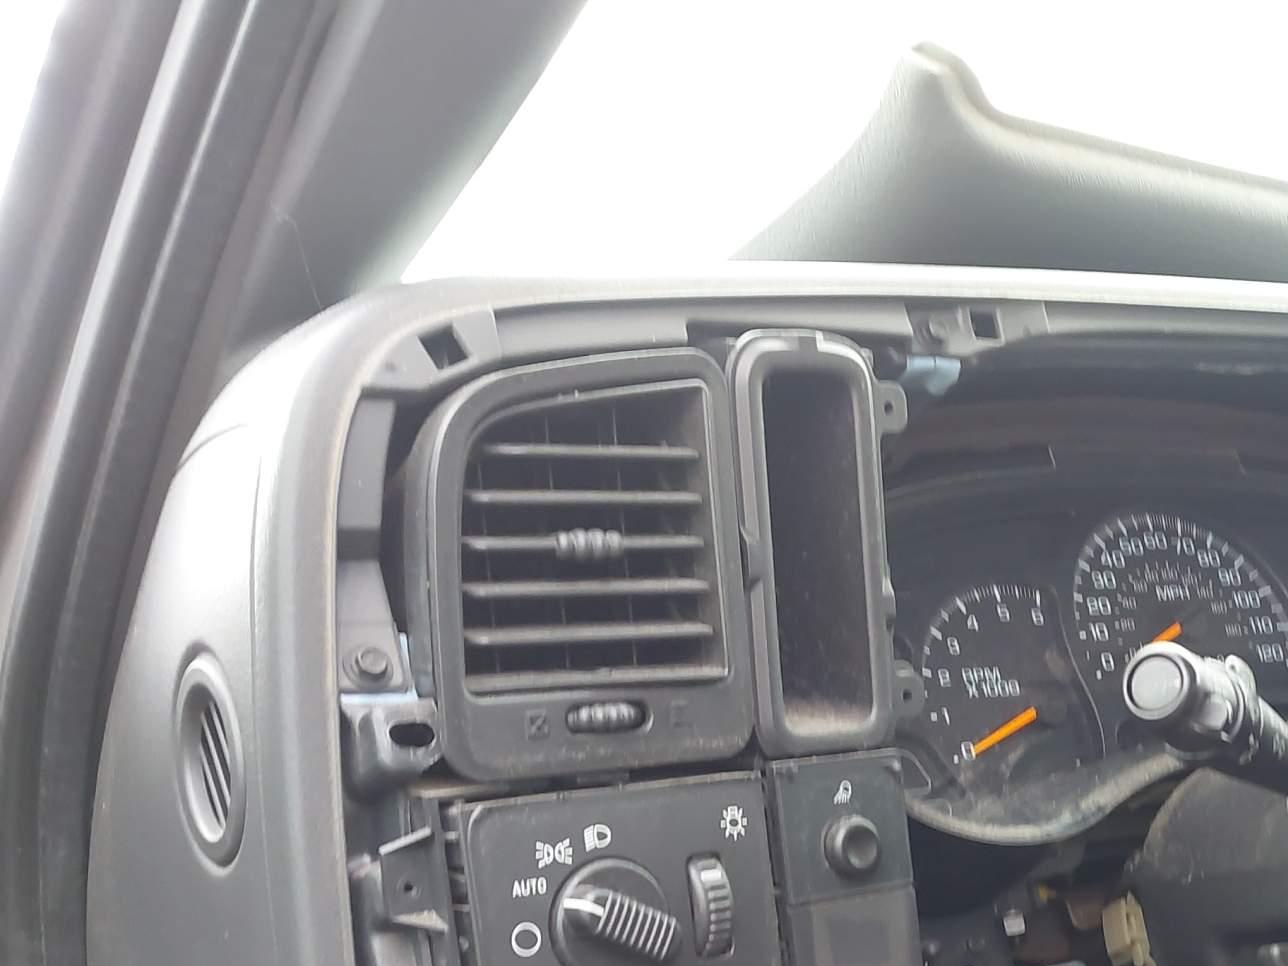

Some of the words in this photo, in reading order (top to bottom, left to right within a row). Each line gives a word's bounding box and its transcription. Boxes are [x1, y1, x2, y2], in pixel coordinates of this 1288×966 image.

[1170, 536, 1195, 555] 70
[1101, 549, 1125, 568] 40
[1155, 584, 1190, 601] MPH
[1231, 590, 1261, 609] 100
[966, 613, 979, 632] 4
[996, 603, 1011, 622] 5
[1089, 621, 1109, 641] 10
[1248, 615, 1274, 635] 110
[1101, 651, 1115, 671] 0
[961, 665, 1001, 685] RPM
[941, 706, 950, 726] 1
[960, 741, 976, 761] 0
[512, 876, 547, 899] AUTO
